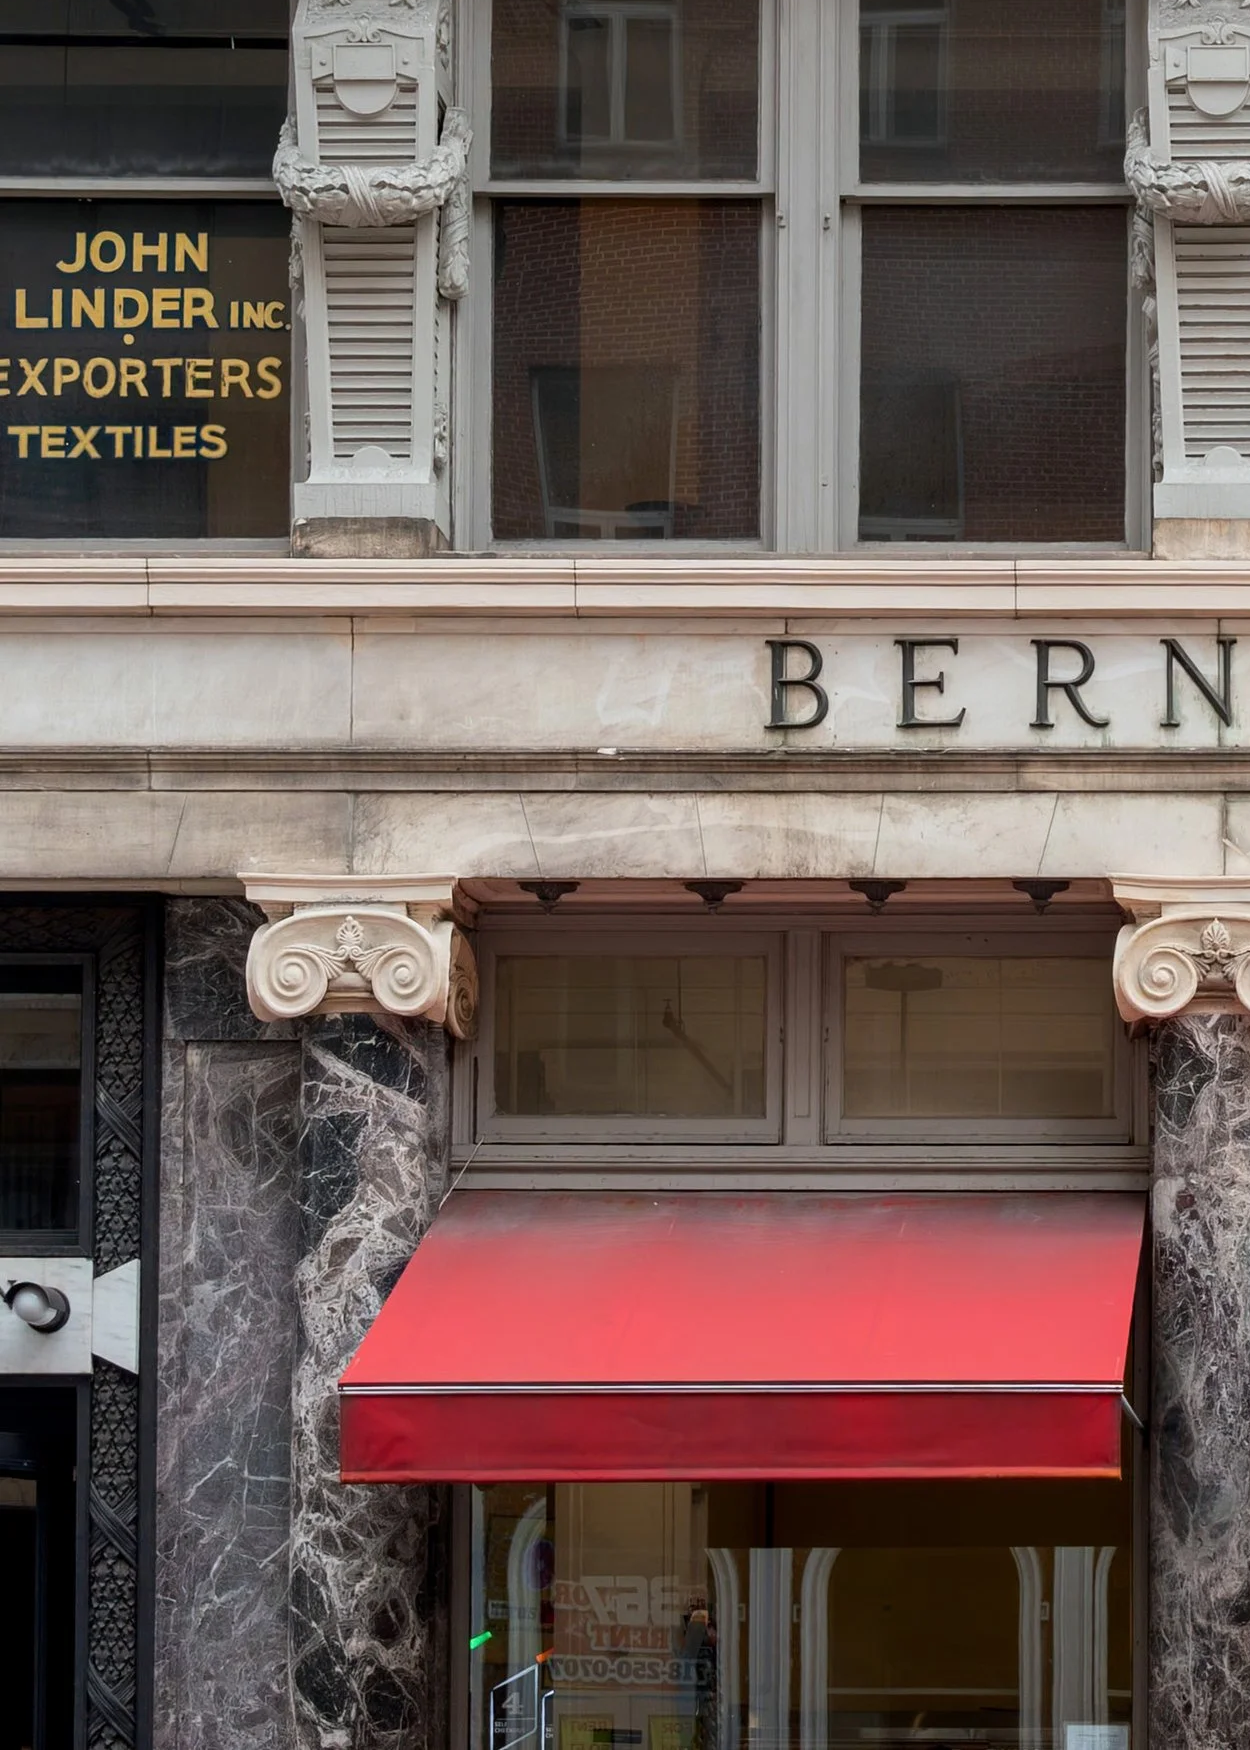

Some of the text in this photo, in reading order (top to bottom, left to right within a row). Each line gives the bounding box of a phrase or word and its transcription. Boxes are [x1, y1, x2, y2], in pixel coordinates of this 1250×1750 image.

[56, 231, 208, 273] JOHN
[15, 288, 291, 331] LINDER INC.
[7, 424, 228, 459] TEXTILES
